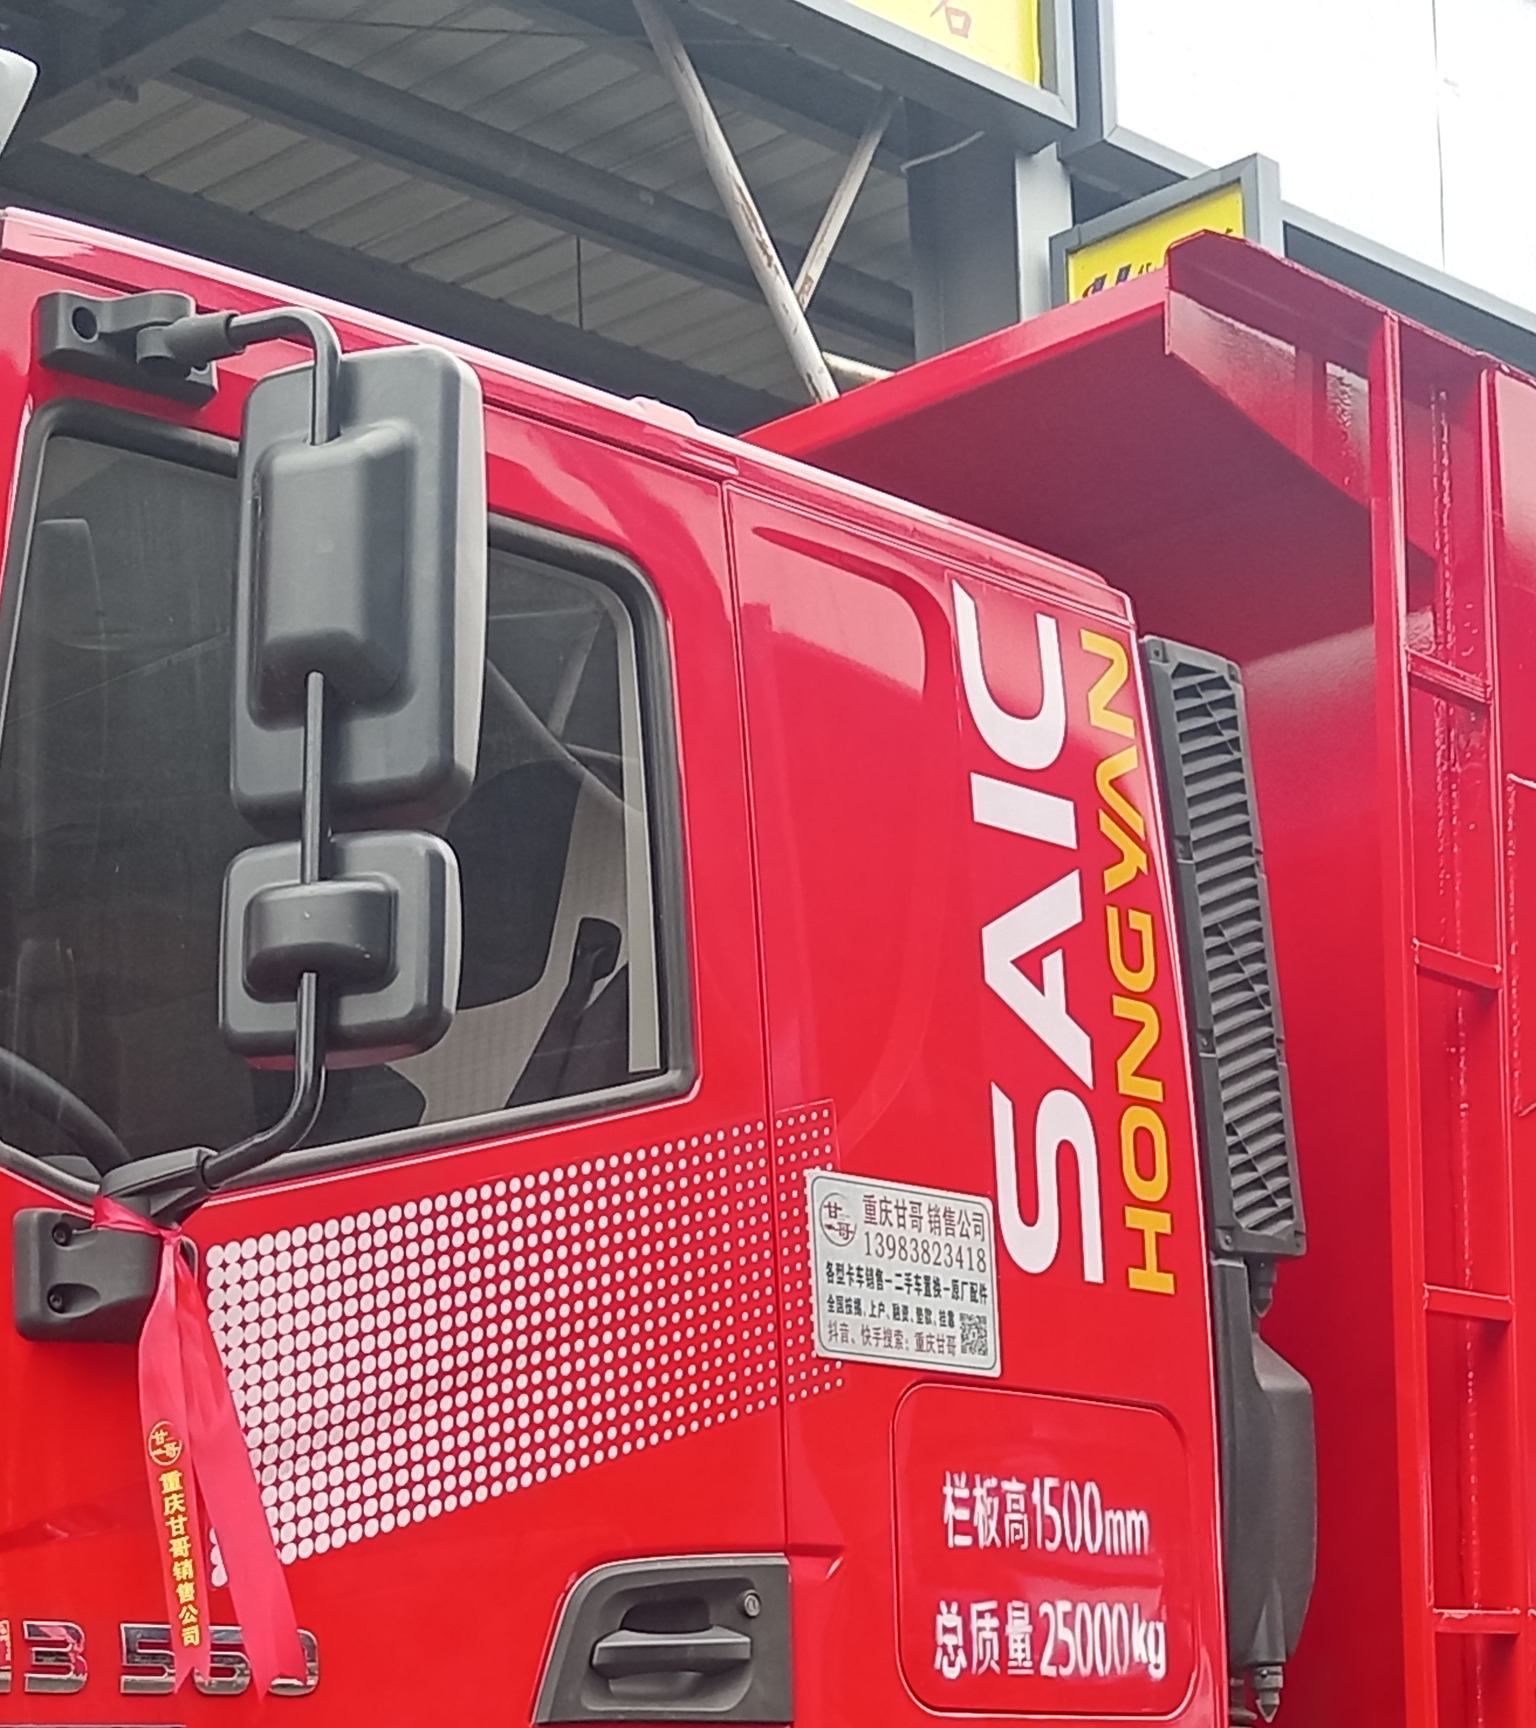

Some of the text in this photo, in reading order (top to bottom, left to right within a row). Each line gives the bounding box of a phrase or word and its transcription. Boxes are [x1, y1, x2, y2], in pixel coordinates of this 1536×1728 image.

[952, 579, 1105, 1284] SAIC
[1078, 628, 1176, 1296] HONGYAN
[864, 1231, 987, 1274] 13983823418
[158, 1469, 202, 1649] 重庆甘哥销售公司
